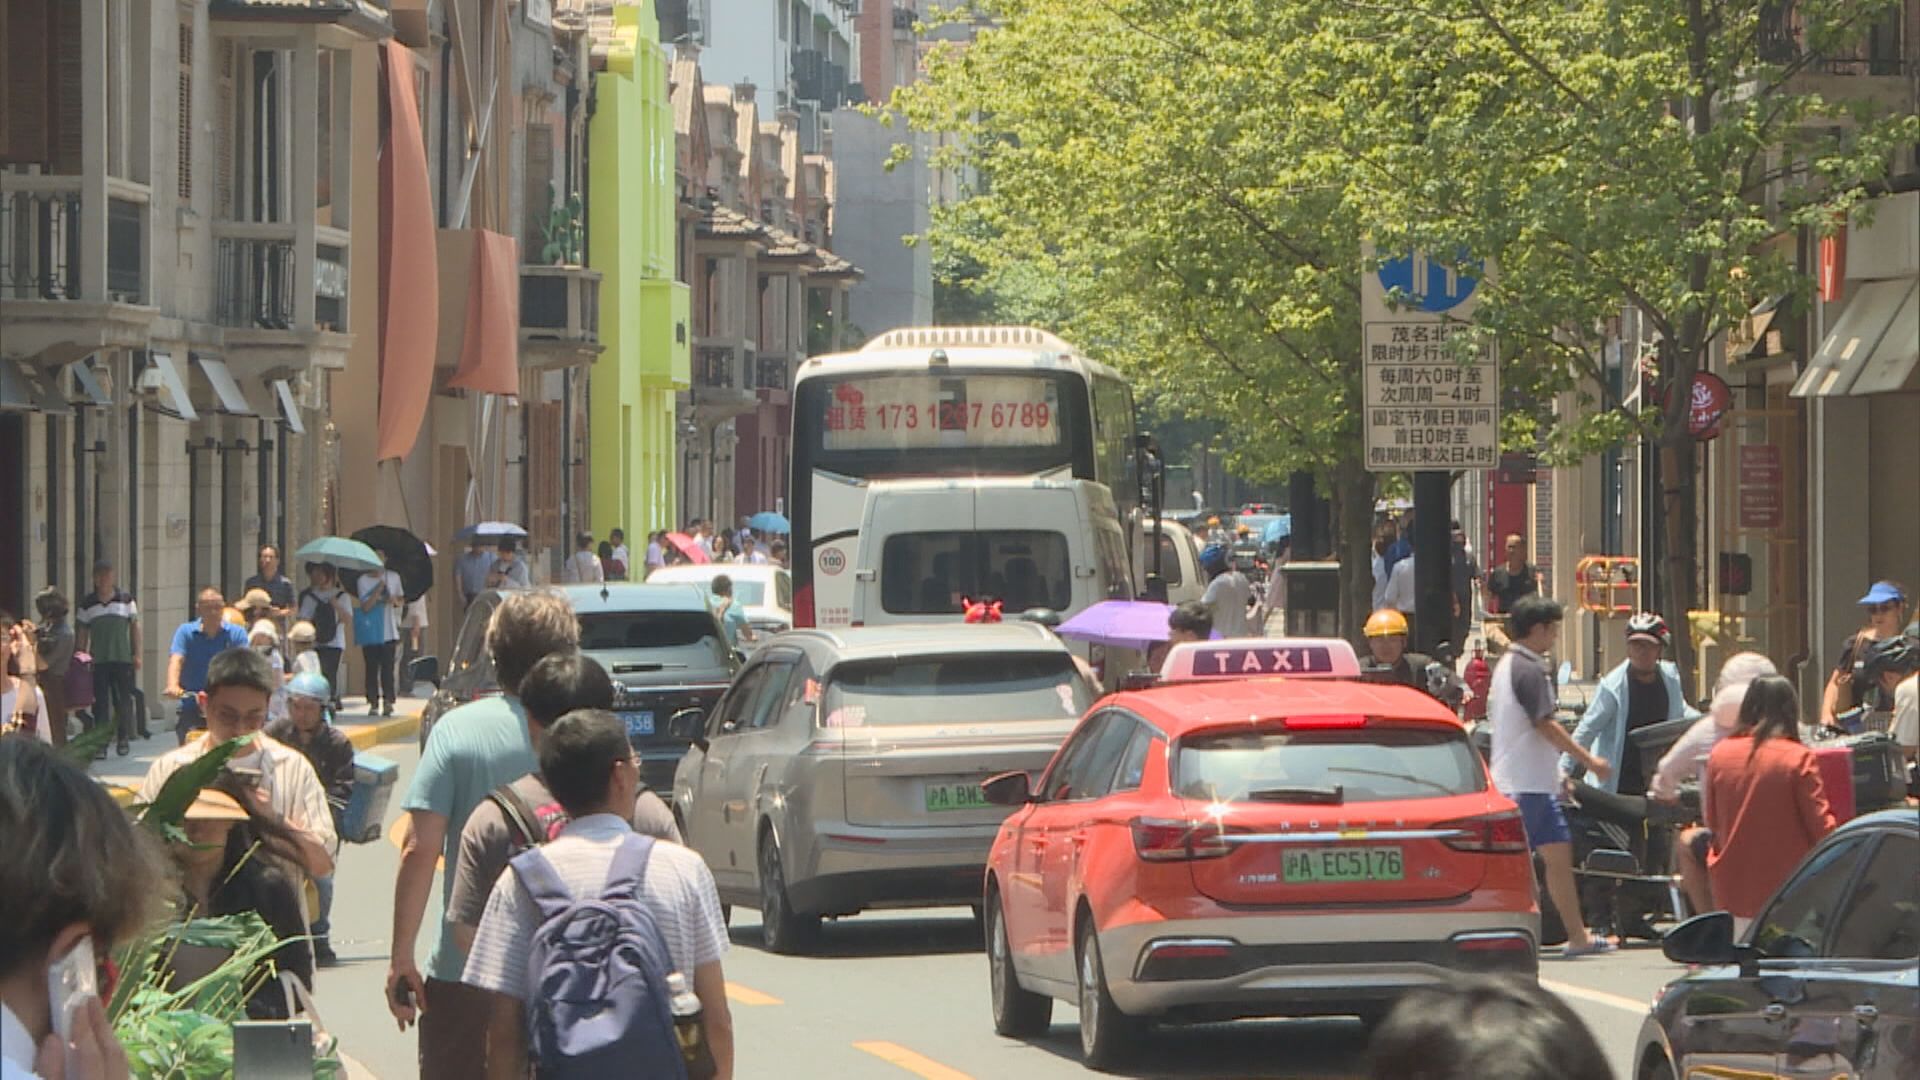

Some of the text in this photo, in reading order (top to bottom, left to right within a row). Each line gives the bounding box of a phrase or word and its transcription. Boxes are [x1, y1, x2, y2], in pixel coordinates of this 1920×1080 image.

[1380, 367, 1482, 384] 每周六0时至
[877, 404, 918, 429] 173
[991, 403, 1049, 428] 6789
[1373, 409, 1490, 426] 国定节假日期间
[1394, 428, 1469, 444] 首日0时至
[823, 556, 842, 567] 100
[1214, 650, 1311, 673] TAXI
